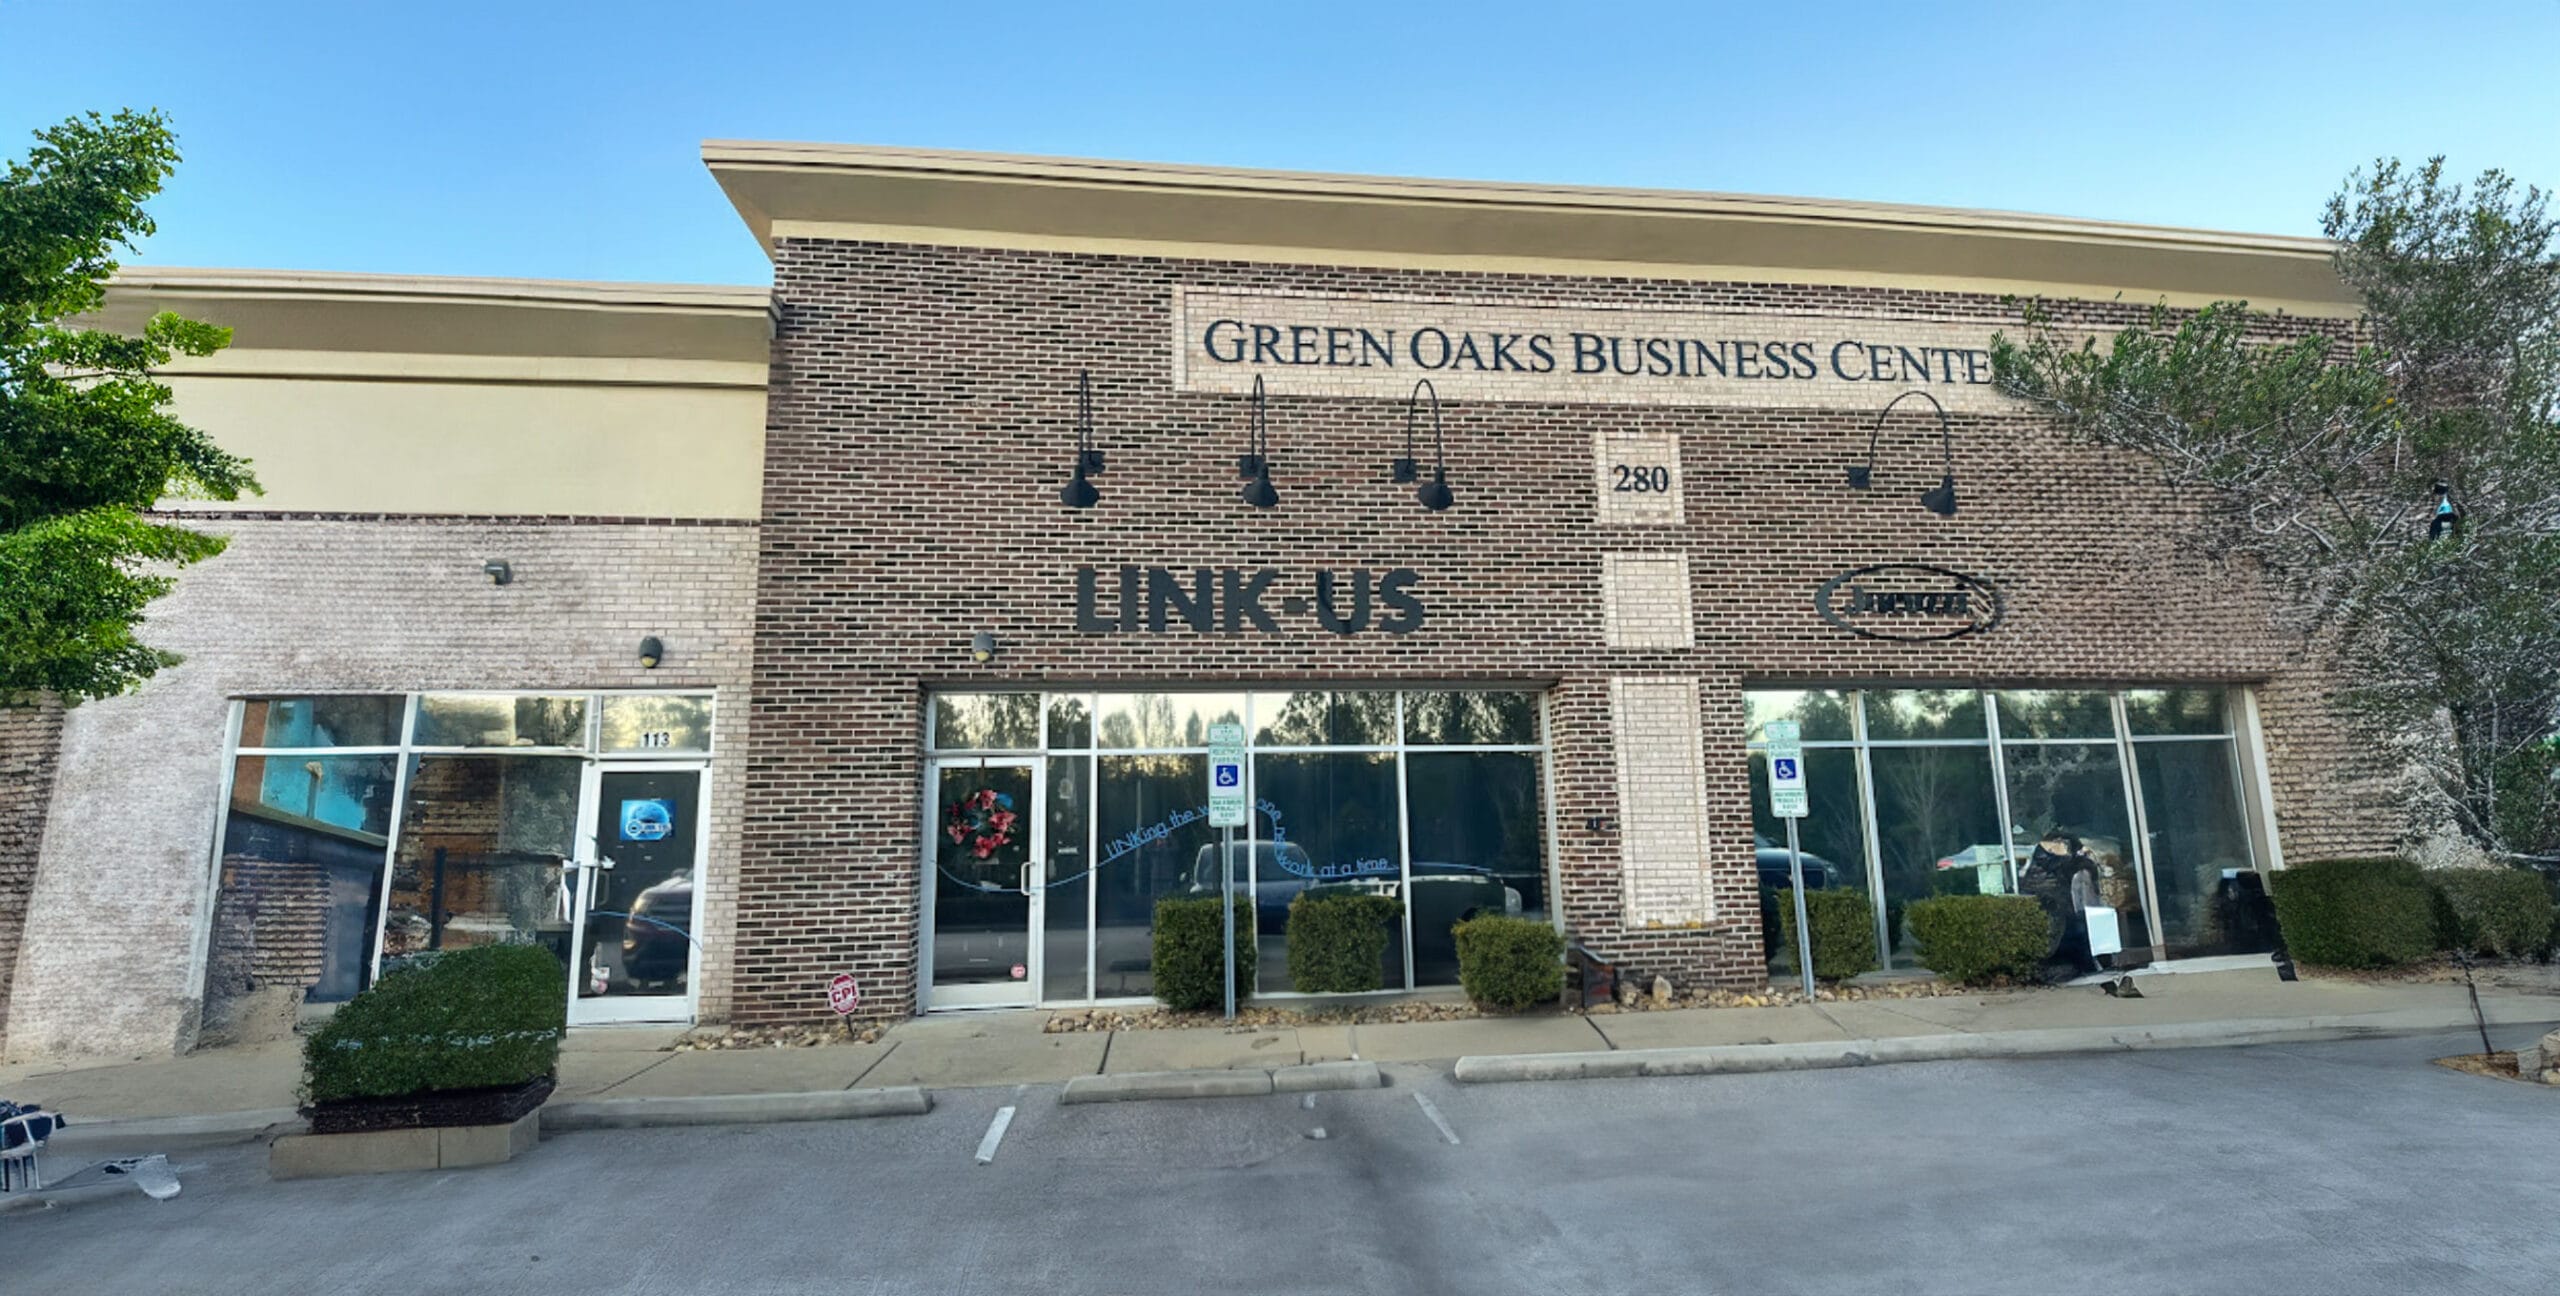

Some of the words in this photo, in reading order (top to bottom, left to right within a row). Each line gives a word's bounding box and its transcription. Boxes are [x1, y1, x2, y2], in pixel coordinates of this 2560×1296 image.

[1203, 319, 1396, 369] GREEN
[1410, 326, 1556, 374] OAKS
[1569, 331, 1819, 381] BUSINESS
[1830, 339, 1994, 386] CENTE
[1613, 464, 1669, 493] 280
[1076, 566, 1425, 635] LINK-US
[643, 732, 670, 748] 113
[1169, 808, 1194, 828] the
[832, 985, 857, 1003] CPI
